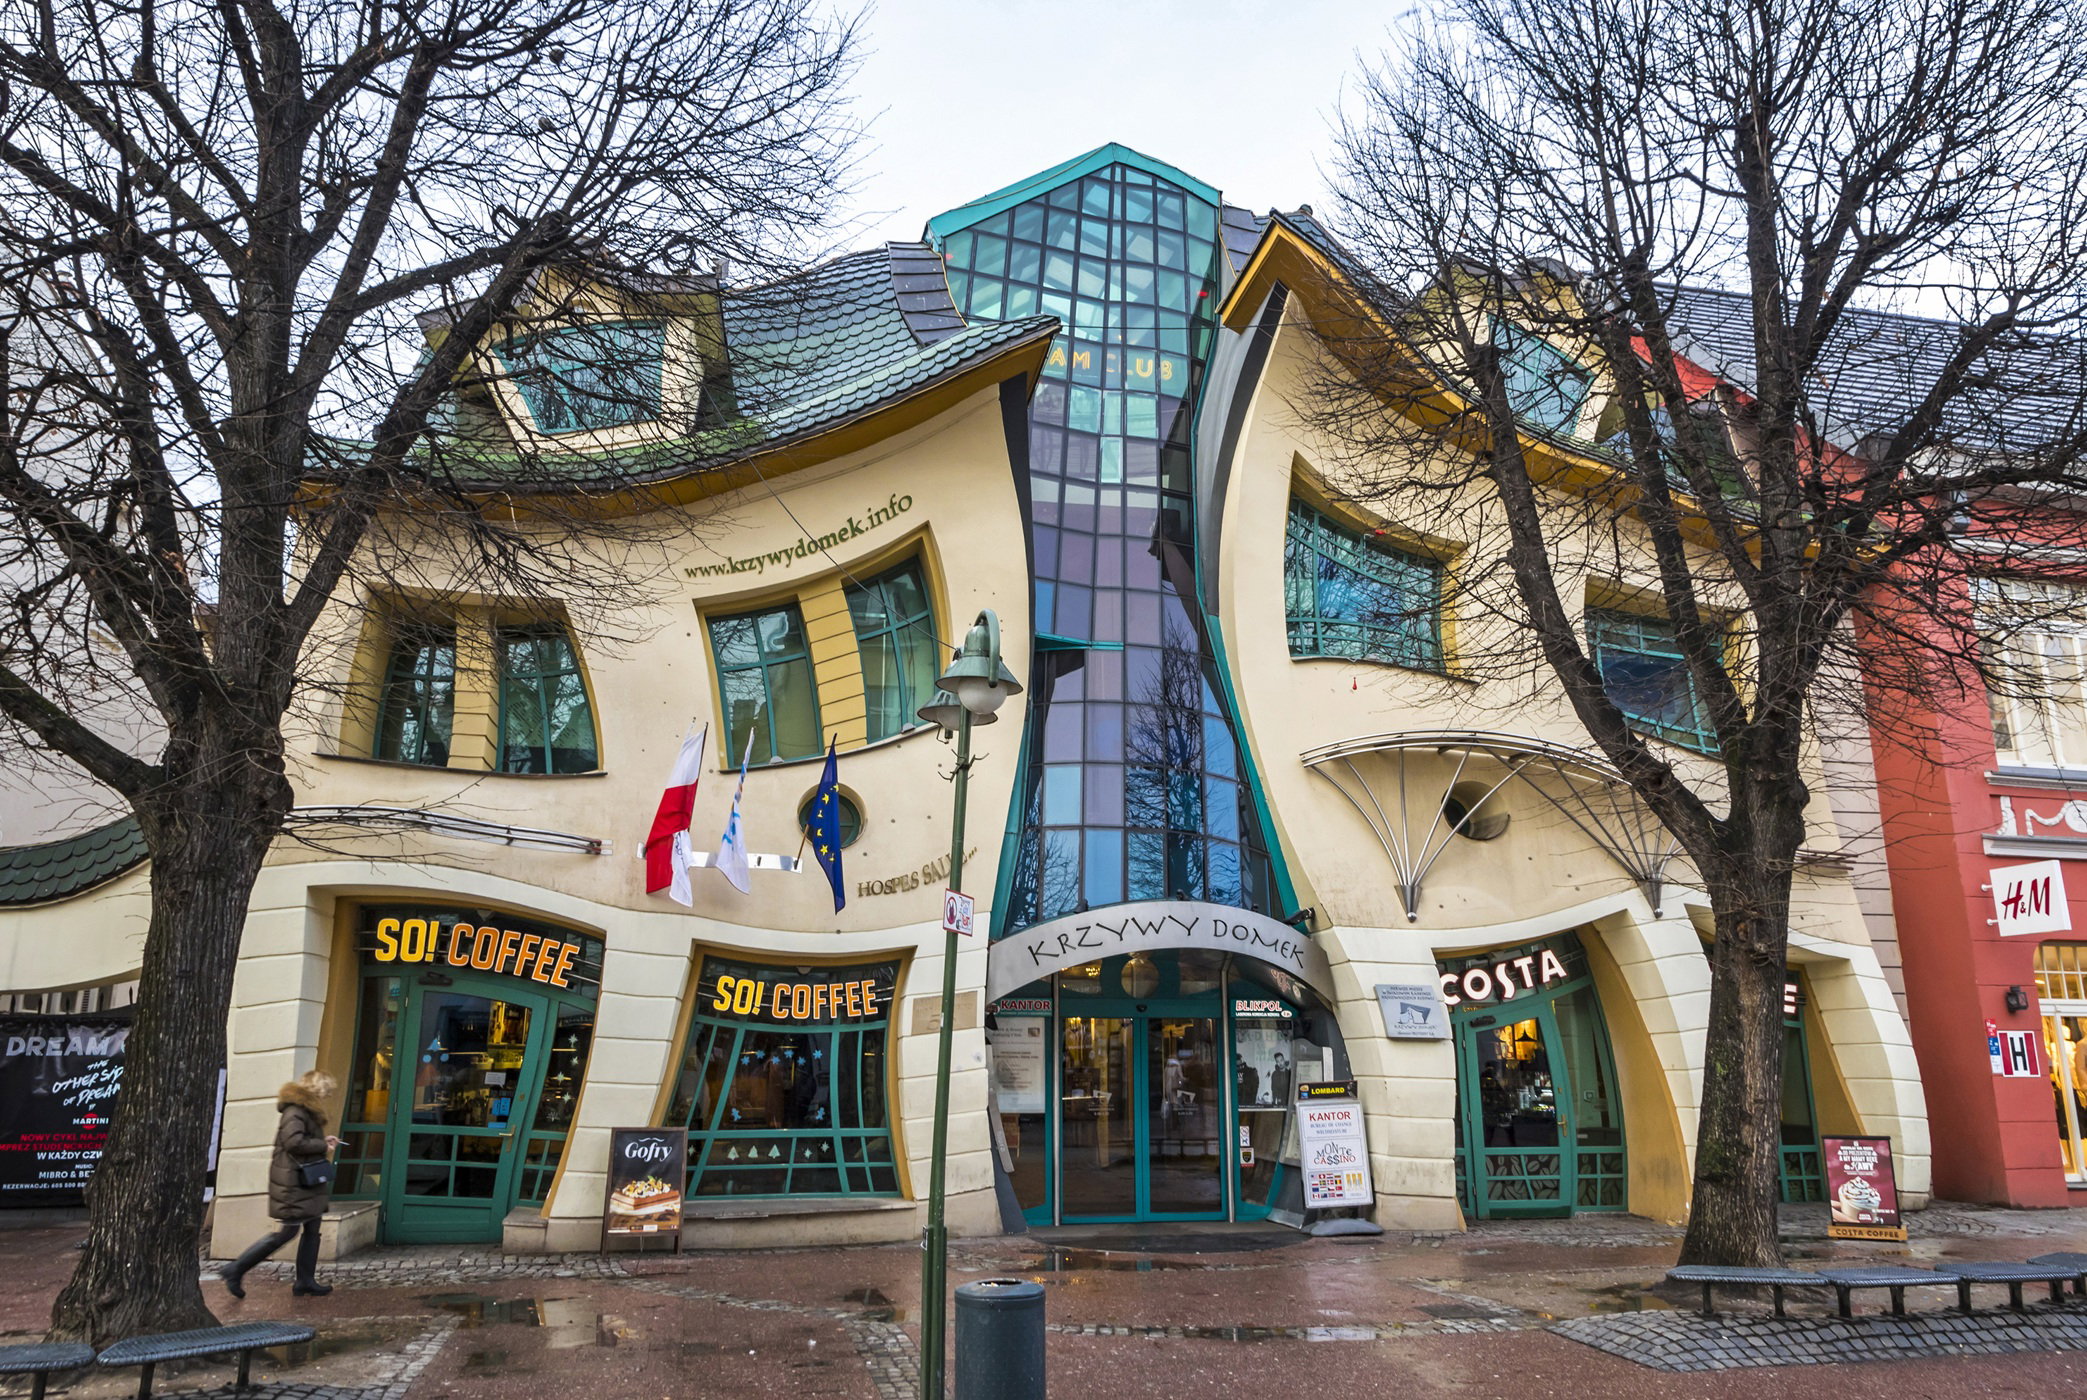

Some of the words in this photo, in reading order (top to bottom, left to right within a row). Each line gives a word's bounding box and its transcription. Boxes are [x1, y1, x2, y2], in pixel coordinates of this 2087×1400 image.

[684, 493, 913, 578] www.krzywydomek.info
[857, 871, 919, 898] HOSPES
[2001, 876, 2050, 920] H&M
[1027, 915, 1199, 966] KRZYWY
[1213, 919, 1304, 969] DOMEK
[375, 918, 440, 963] SO!
[447, 923, 580, 988] COFFEE
[1440, 949, 1568, 1006] COSTA
[713, 975, 765, 1016] SO!
[771, 979, 878, 1020] COFFEE
[1001, 1000, 1051, 1011] KANTOR
[1235, 1000, 1283, 1011] BLIKPOL
[6, 1036, 110, 1057] DREAM
[2010, 1037, 2028, 1071] H
[52, 1073, 100, 1094] OTHER
[1311, 1087, 1345, 1095] LOMBARD
[73, 1117, 109, 1125] MARTINI
[1309, 1111, 1351, 1121] KANTOR
[20, 1134, 51, 1142] NOWY
[37, 1152, 47, 1160] W
[48, 1150, 81, 1160] KAŻDY
[625, 1142, 672, 1161] Gofry
[39, 1171, 68, 1179] MIBRO
[79, 1170, 95, 1178] BE
[1836, 1228, 1863, 1236] COSTA
[1866, 1229, 1899, 1238] COFFEE
